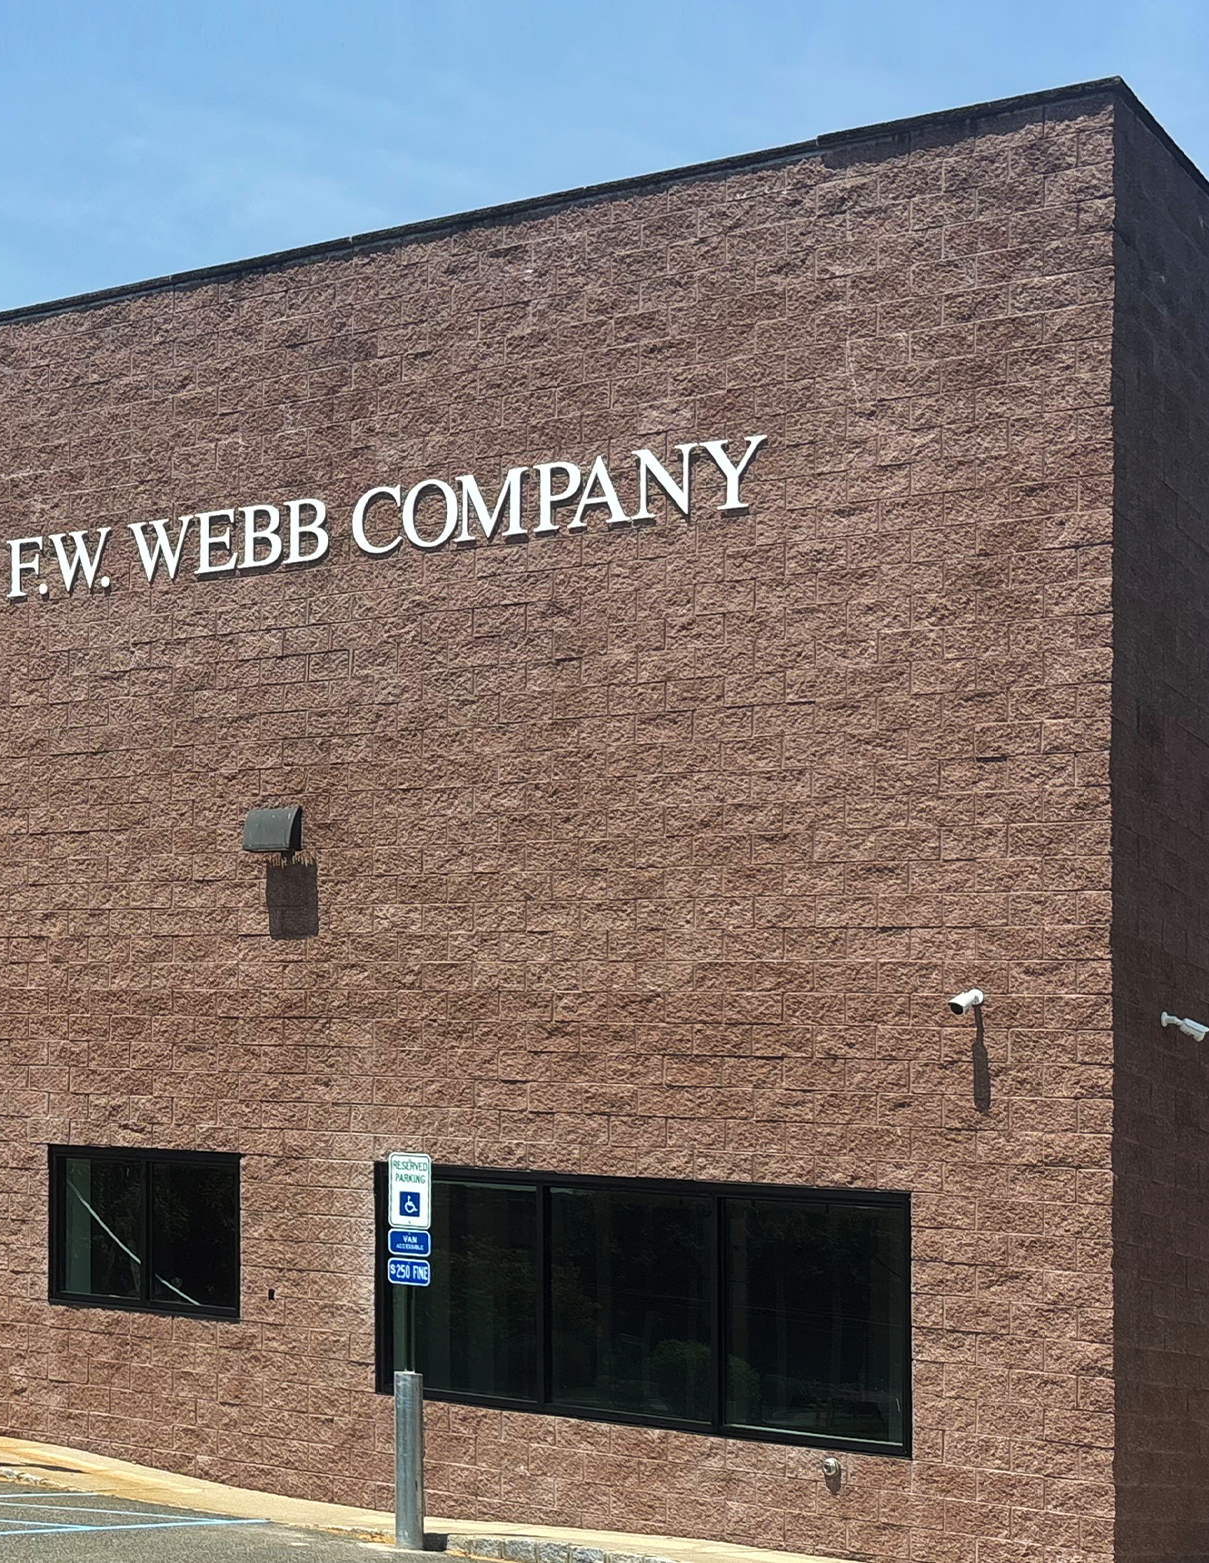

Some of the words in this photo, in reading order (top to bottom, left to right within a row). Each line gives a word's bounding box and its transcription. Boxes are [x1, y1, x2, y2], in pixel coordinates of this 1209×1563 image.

[5, 526, 112, 599] F.W.
[127, 498, 330, 583] WEBB
[351, 433, 769, 554] COMPANY
[393, 1160, 428, 1172] RESERVED
[395, 1173, 426, 1185] PARKING
[402, 1235, 418, 1244] VAN
[390, 1264, 411, 1280] $250
[412, 1265, 428, 1280] FINE
